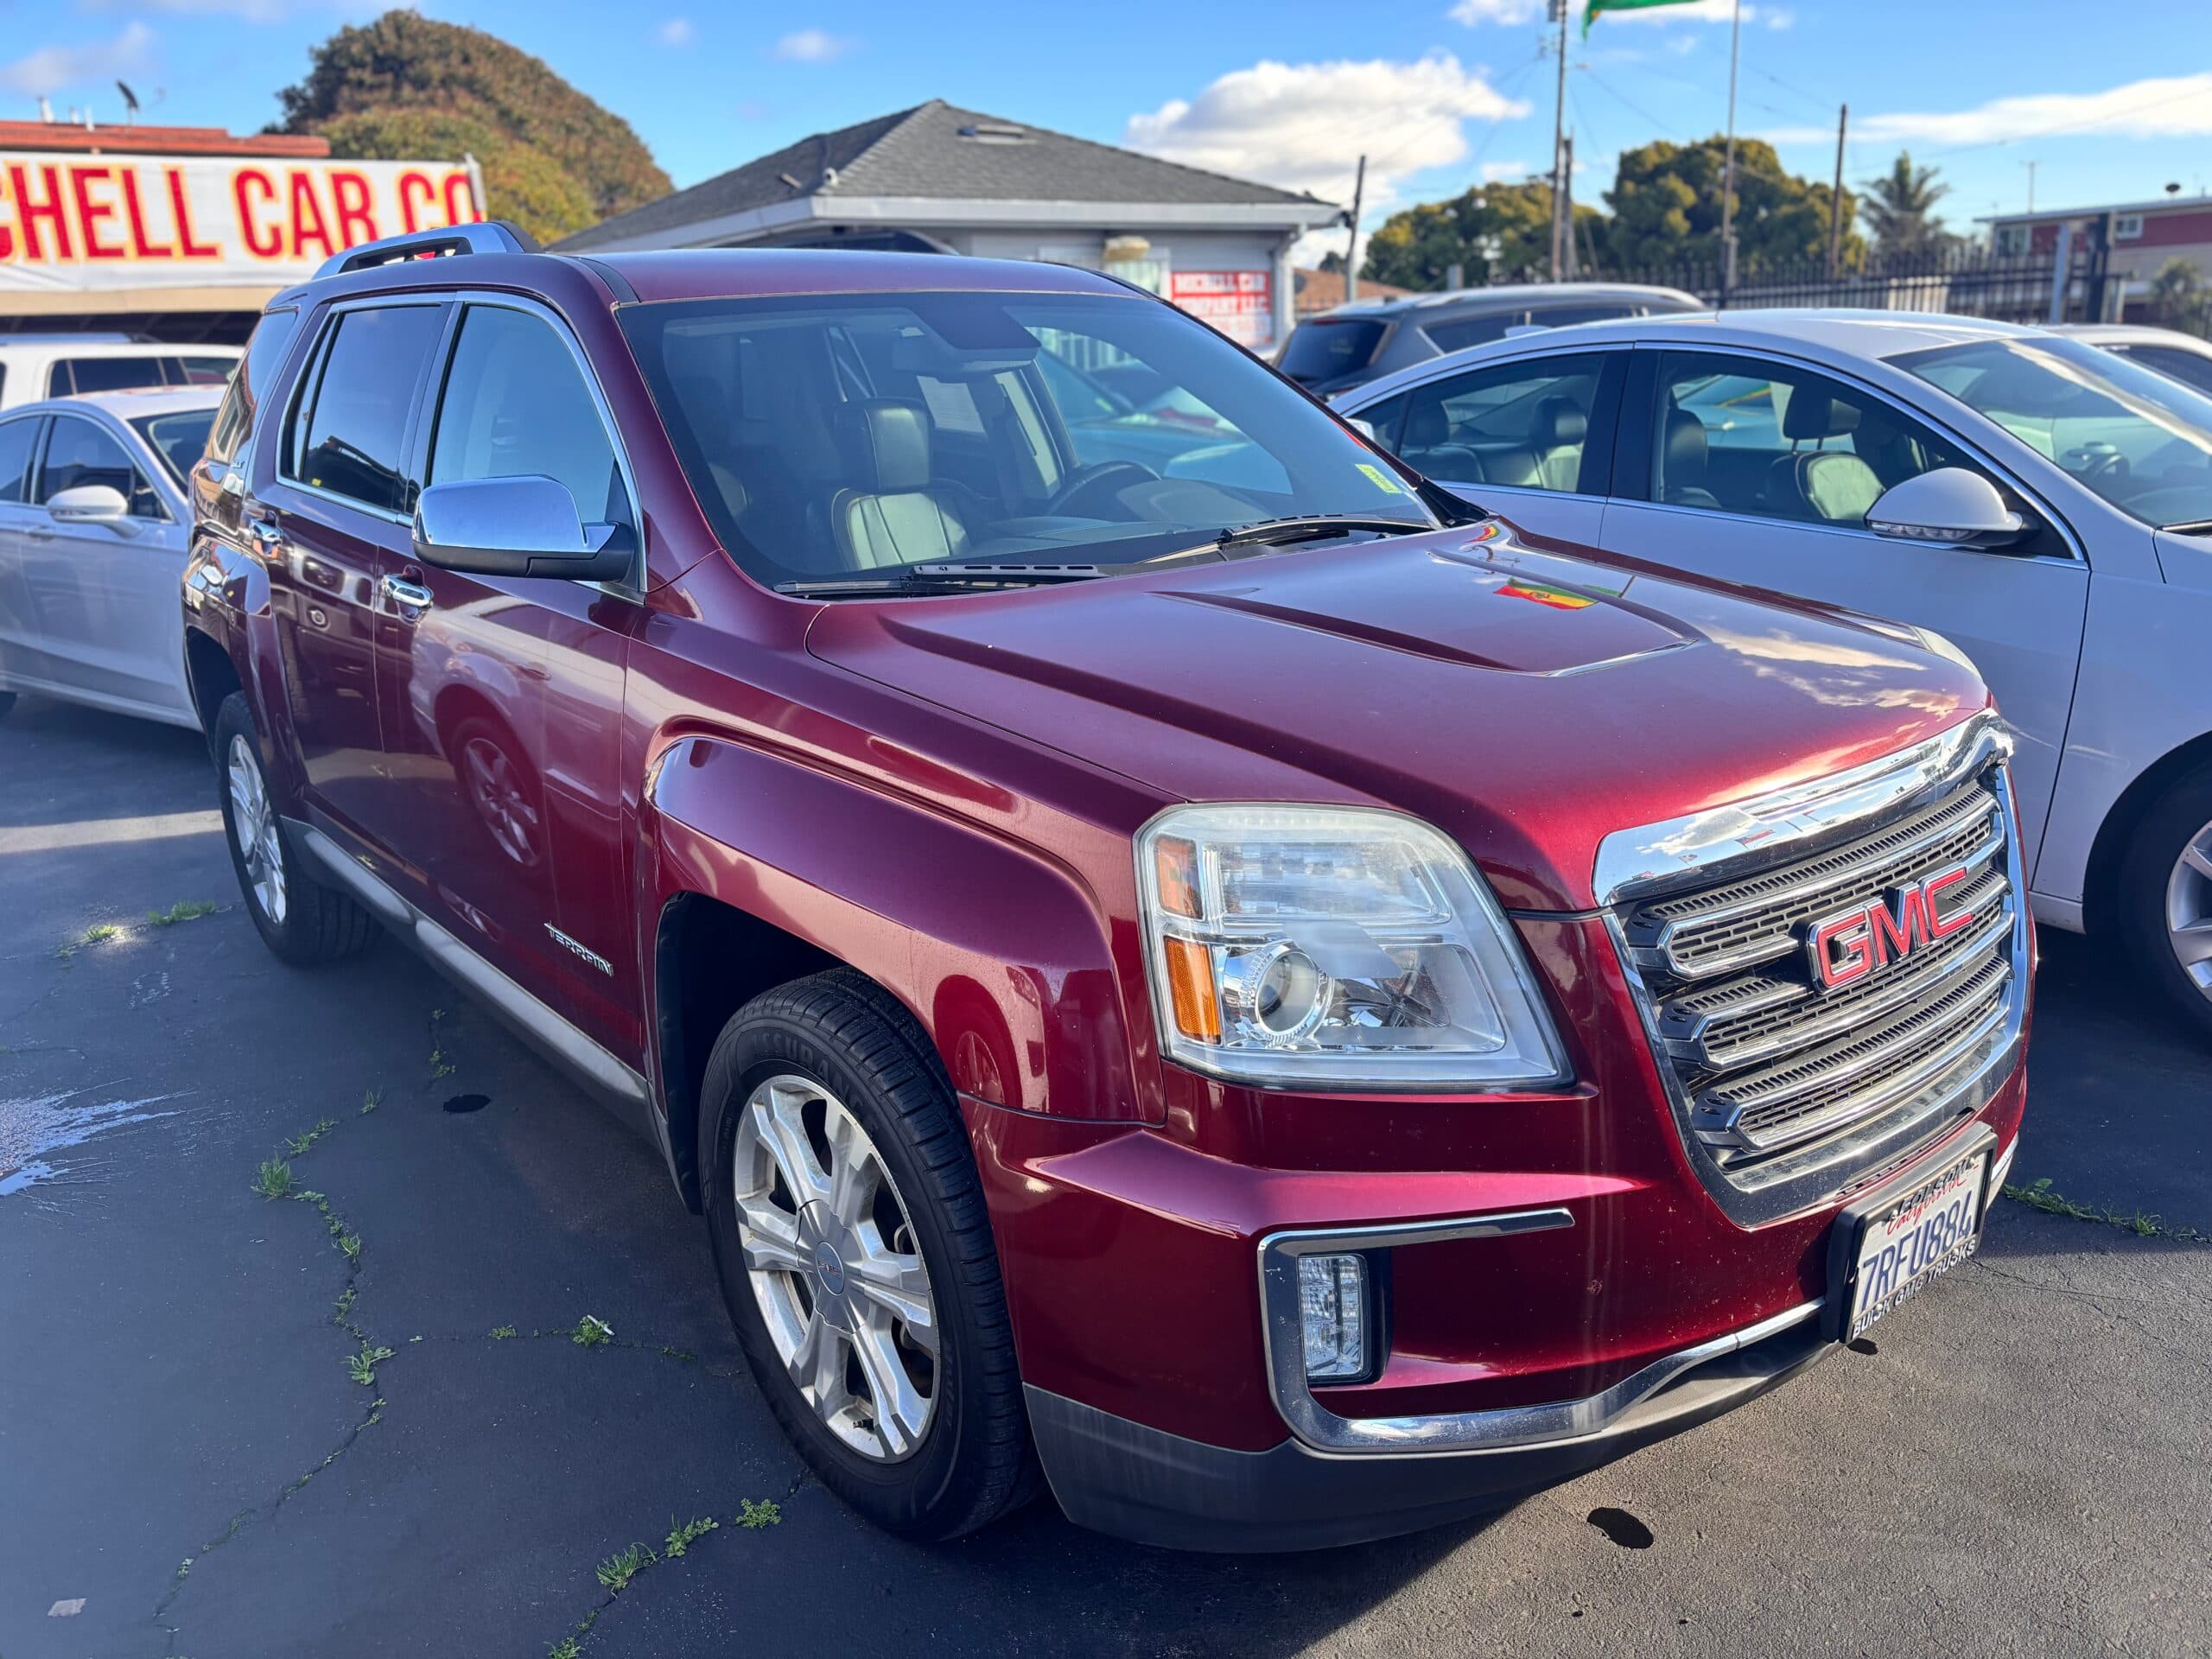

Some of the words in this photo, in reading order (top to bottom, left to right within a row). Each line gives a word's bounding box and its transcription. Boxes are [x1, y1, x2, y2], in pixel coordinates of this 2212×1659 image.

[234, 168, 379, 258] CAR
[543, 920, 614, 978] TERRAIN
[1812, 867, 1974, 989] GMC
[1860, 1190, 1973, 1313] 7RFU884
[1894, 1274, 1923, 1306] GMC
